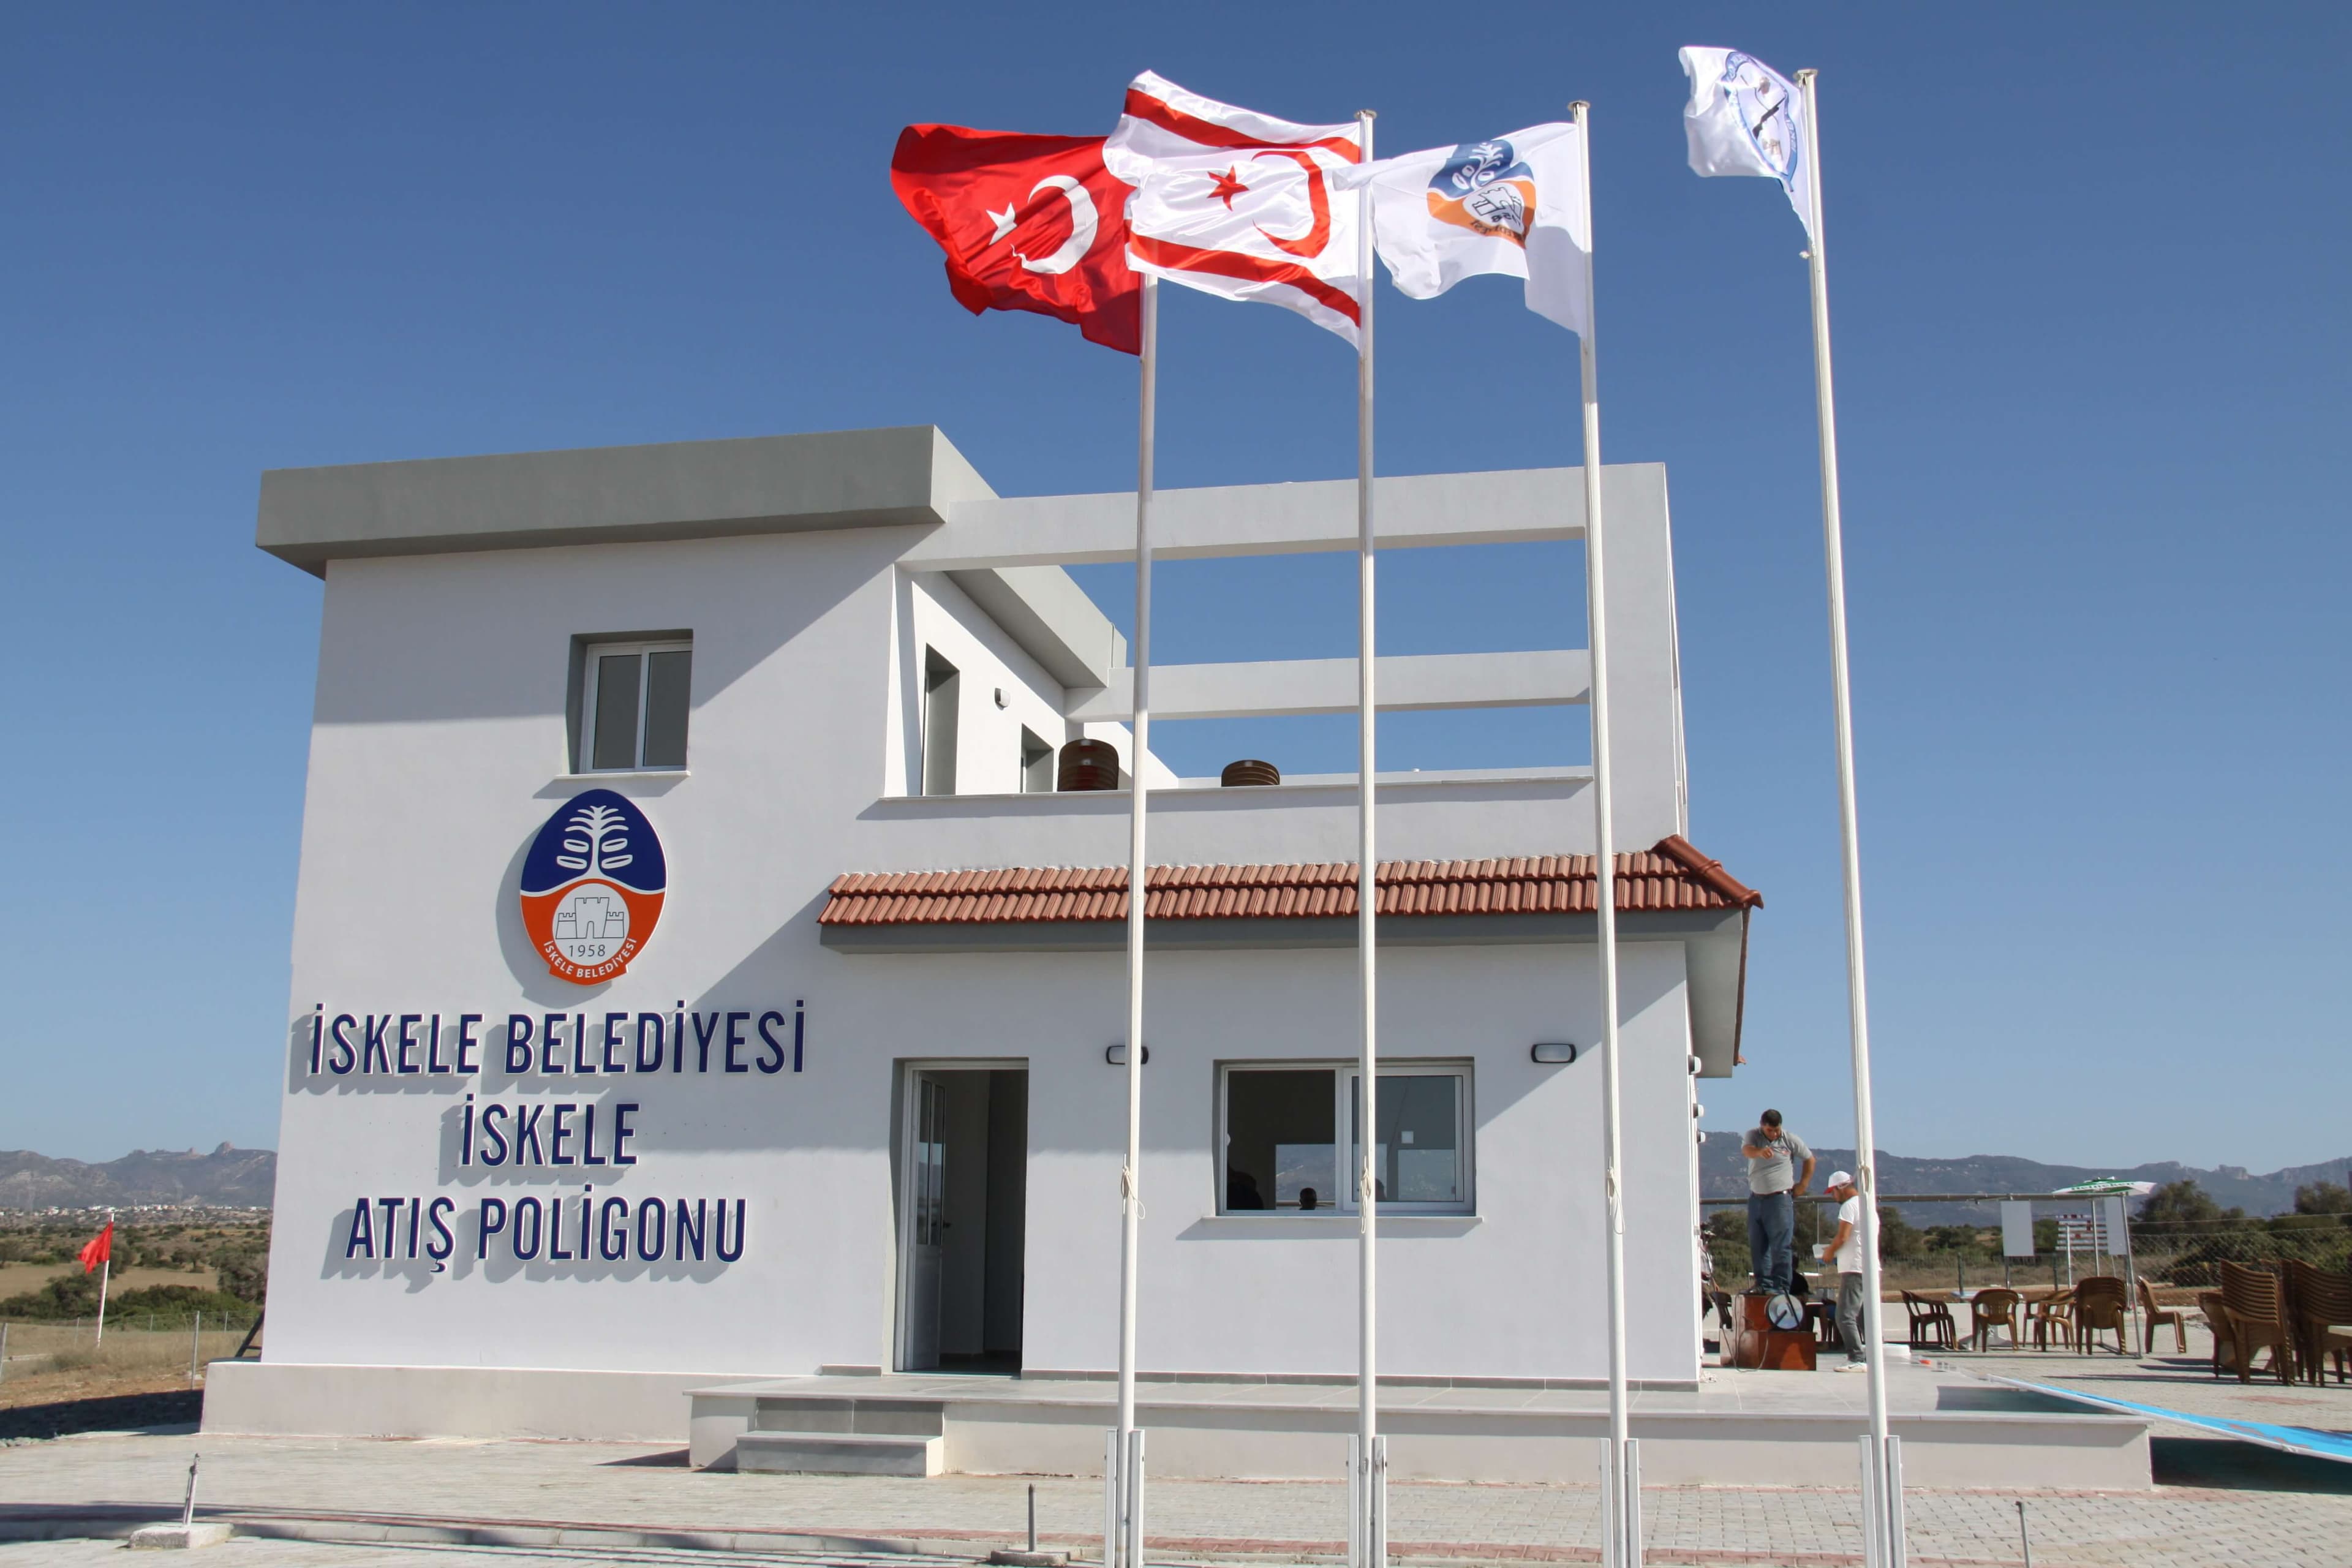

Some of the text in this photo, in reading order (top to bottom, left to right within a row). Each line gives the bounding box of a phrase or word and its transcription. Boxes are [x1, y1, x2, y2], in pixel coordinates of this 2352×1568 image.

[543, 937, 637, 978] İSKELE BELEDİYESİ
[568, 944, 606, 957] 1958
[311, 999, 806, 1076] İSKELE BELEDİYESİ
[461, 1093, 641, 1166] İSKELE
[345, 1183, 747, 1272] ATIŞ POLİGONU
